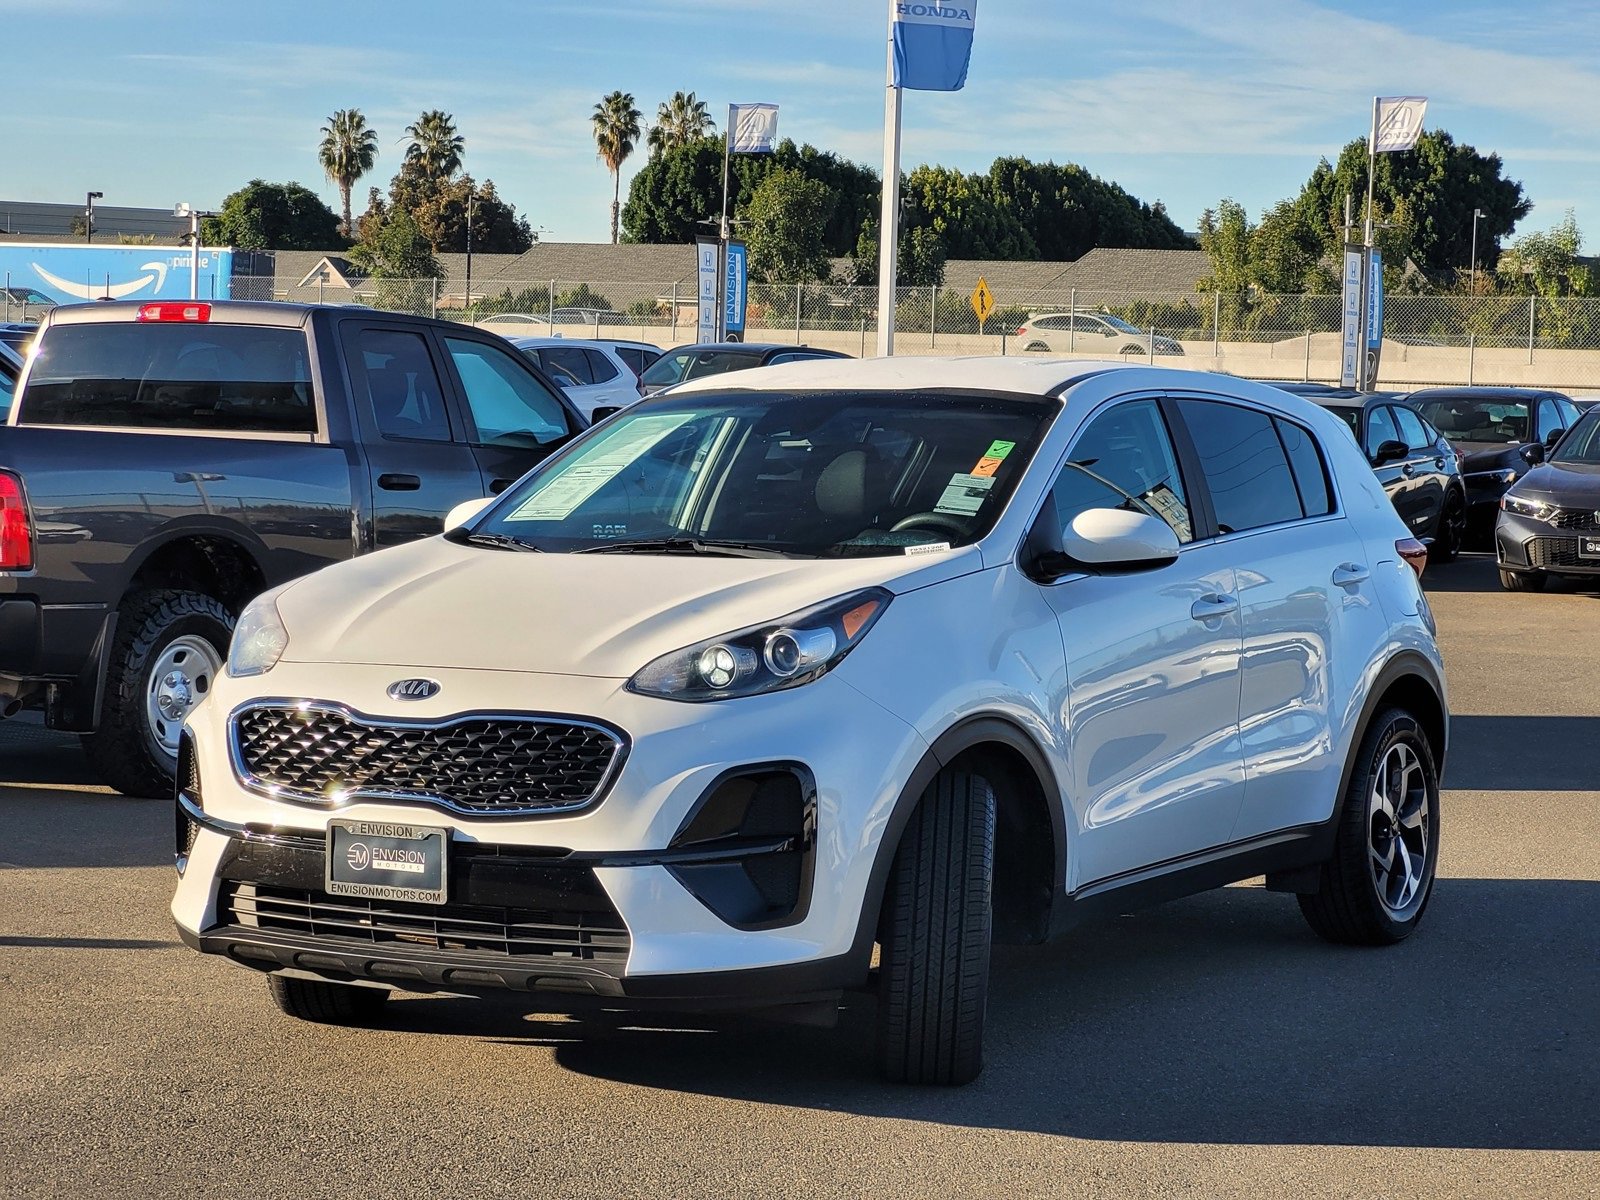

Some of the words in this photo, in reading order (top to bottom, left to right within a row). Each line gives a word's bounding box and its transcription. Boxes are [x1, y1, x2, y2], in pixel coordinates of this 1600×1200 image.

[896, 3, 972, 20] HONDA
[727, 252, 736, 324] ENVISION
[395, 680, 430, 696] KIA
[360, 823, 413, 838] ENVISION
[372, 847, 426, 864] ENVISION
[376, 862, 421, 871] MOTORS
[331, 883, 441, 902] ENVISIONMOTORS.COM
